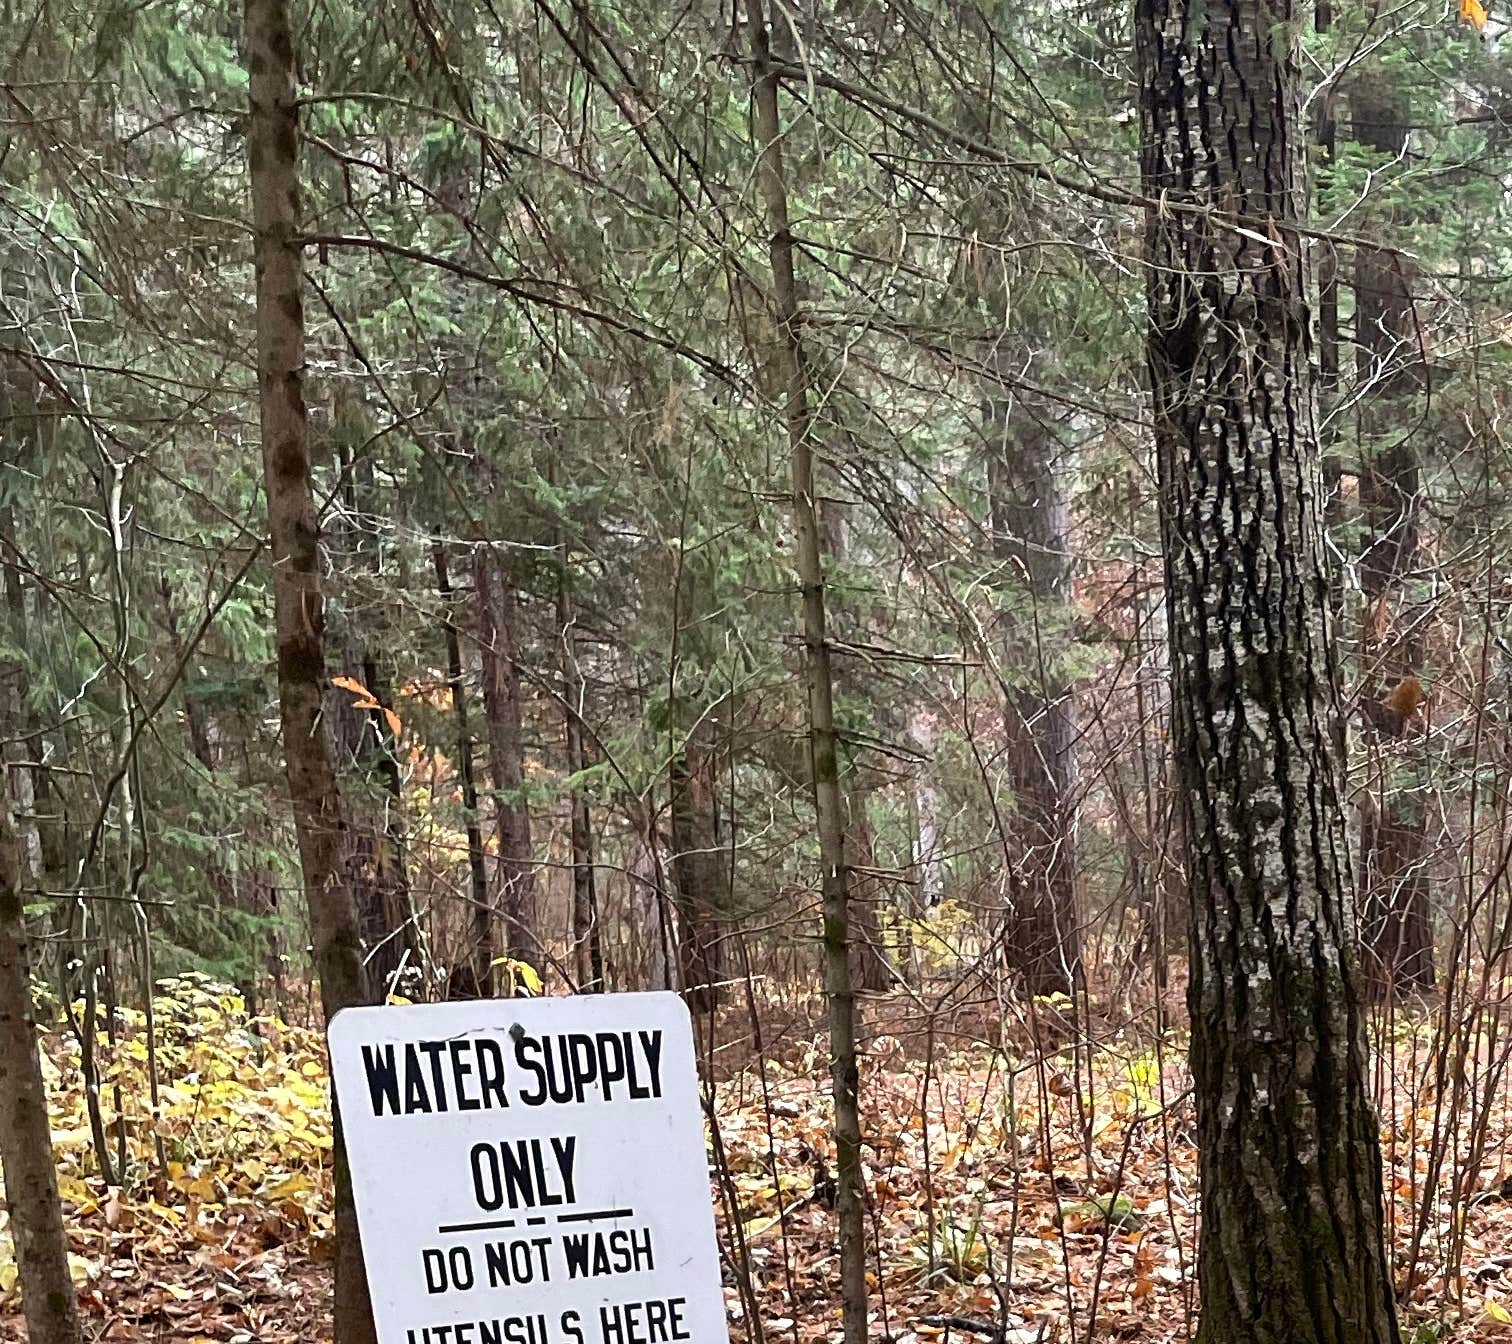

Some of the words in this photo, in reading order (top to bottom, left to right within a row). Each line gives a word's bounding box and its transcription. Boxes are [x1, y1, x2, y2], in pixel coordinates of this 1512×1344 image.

[361, 1039, 509, 1116] WATER
[514, 1030, 662, 1106] SUPPLY
[470, 1136, 576, 1211] ONLY
[422, 1246, 474, 1294] DO
[484, 1237, 552, 1288] NOT
[562, 1228, 654, 1280] WASH
